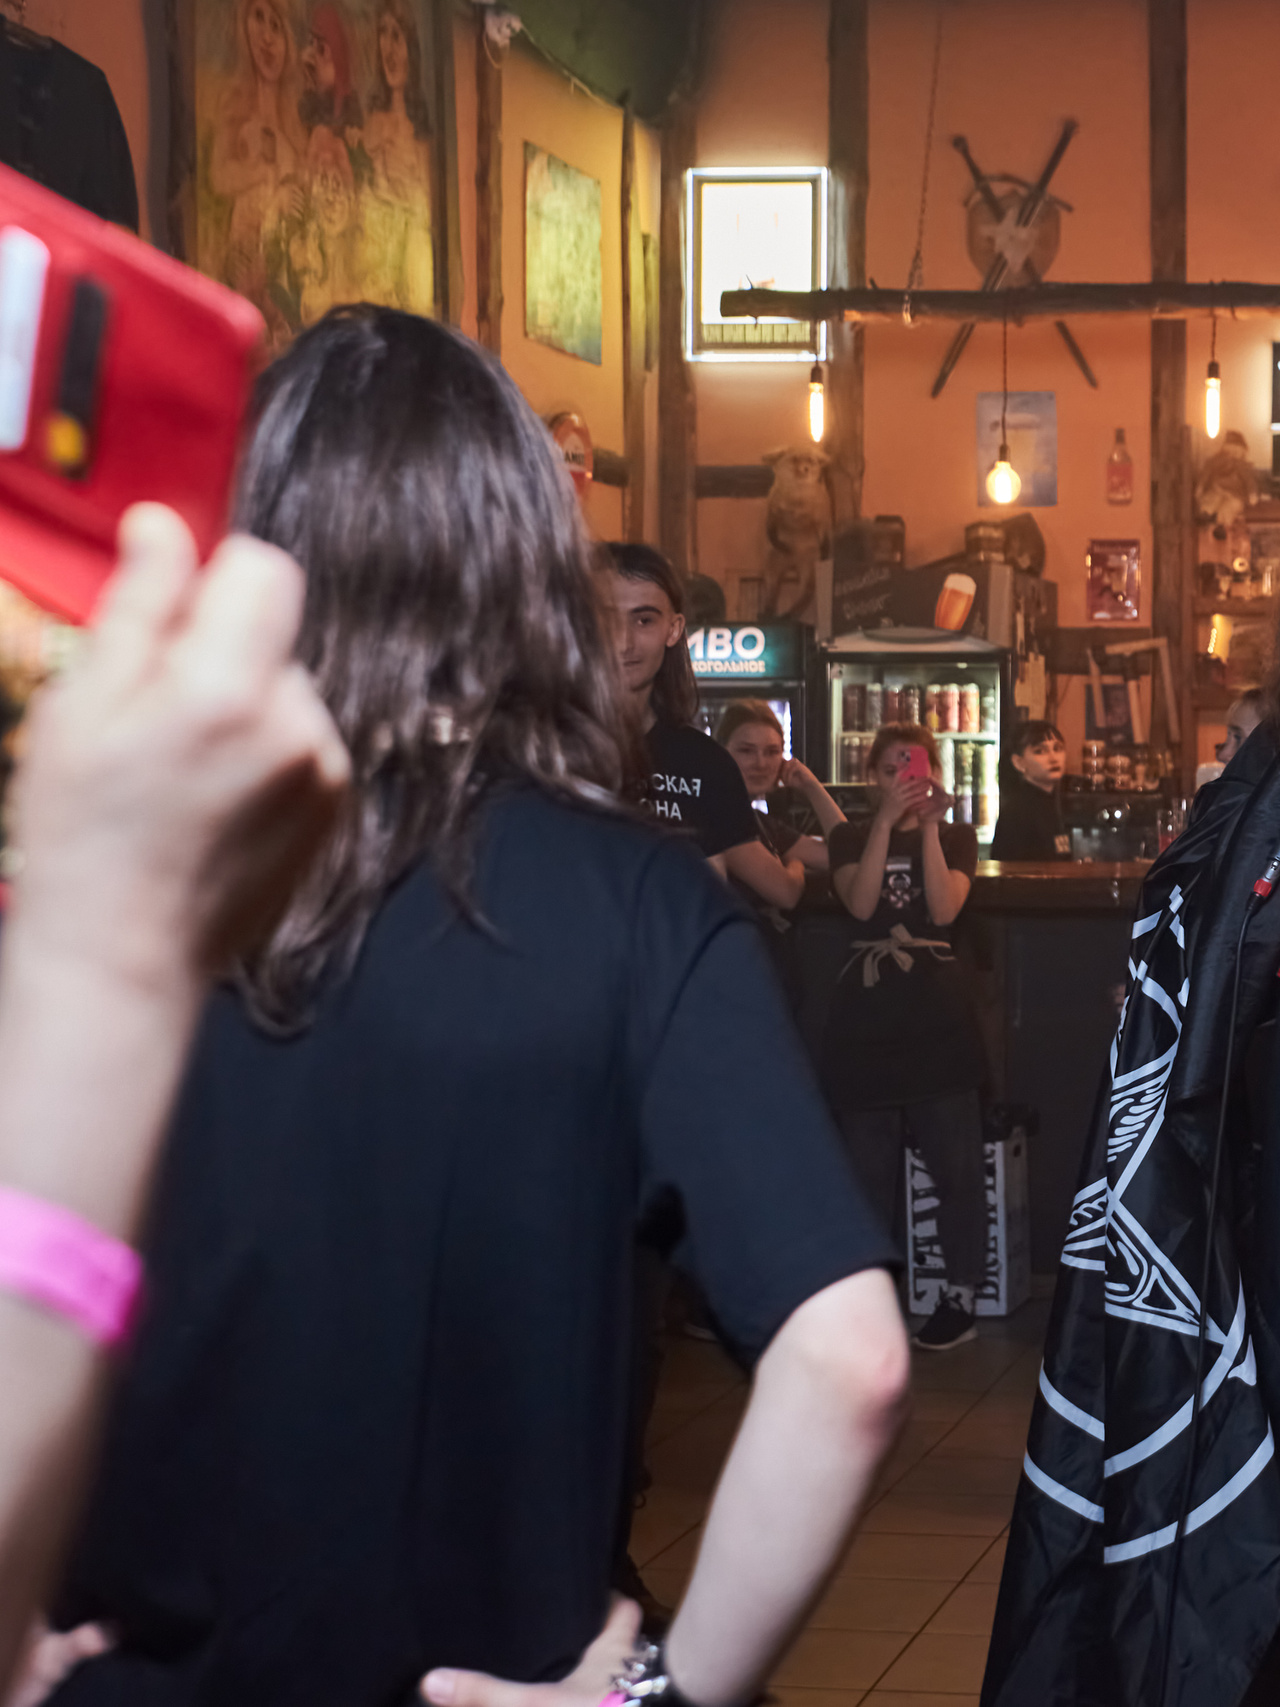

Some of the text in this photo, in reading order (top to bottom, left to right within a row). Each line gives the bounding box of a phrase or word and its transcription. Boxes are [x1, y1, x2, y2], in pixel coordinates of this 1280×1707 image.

[687, 626, 766, 660] ИВО
[692, 660, 766, 672] КОГОЛЬНОЕ
[652, 773, 702, 797] СКАЯ
